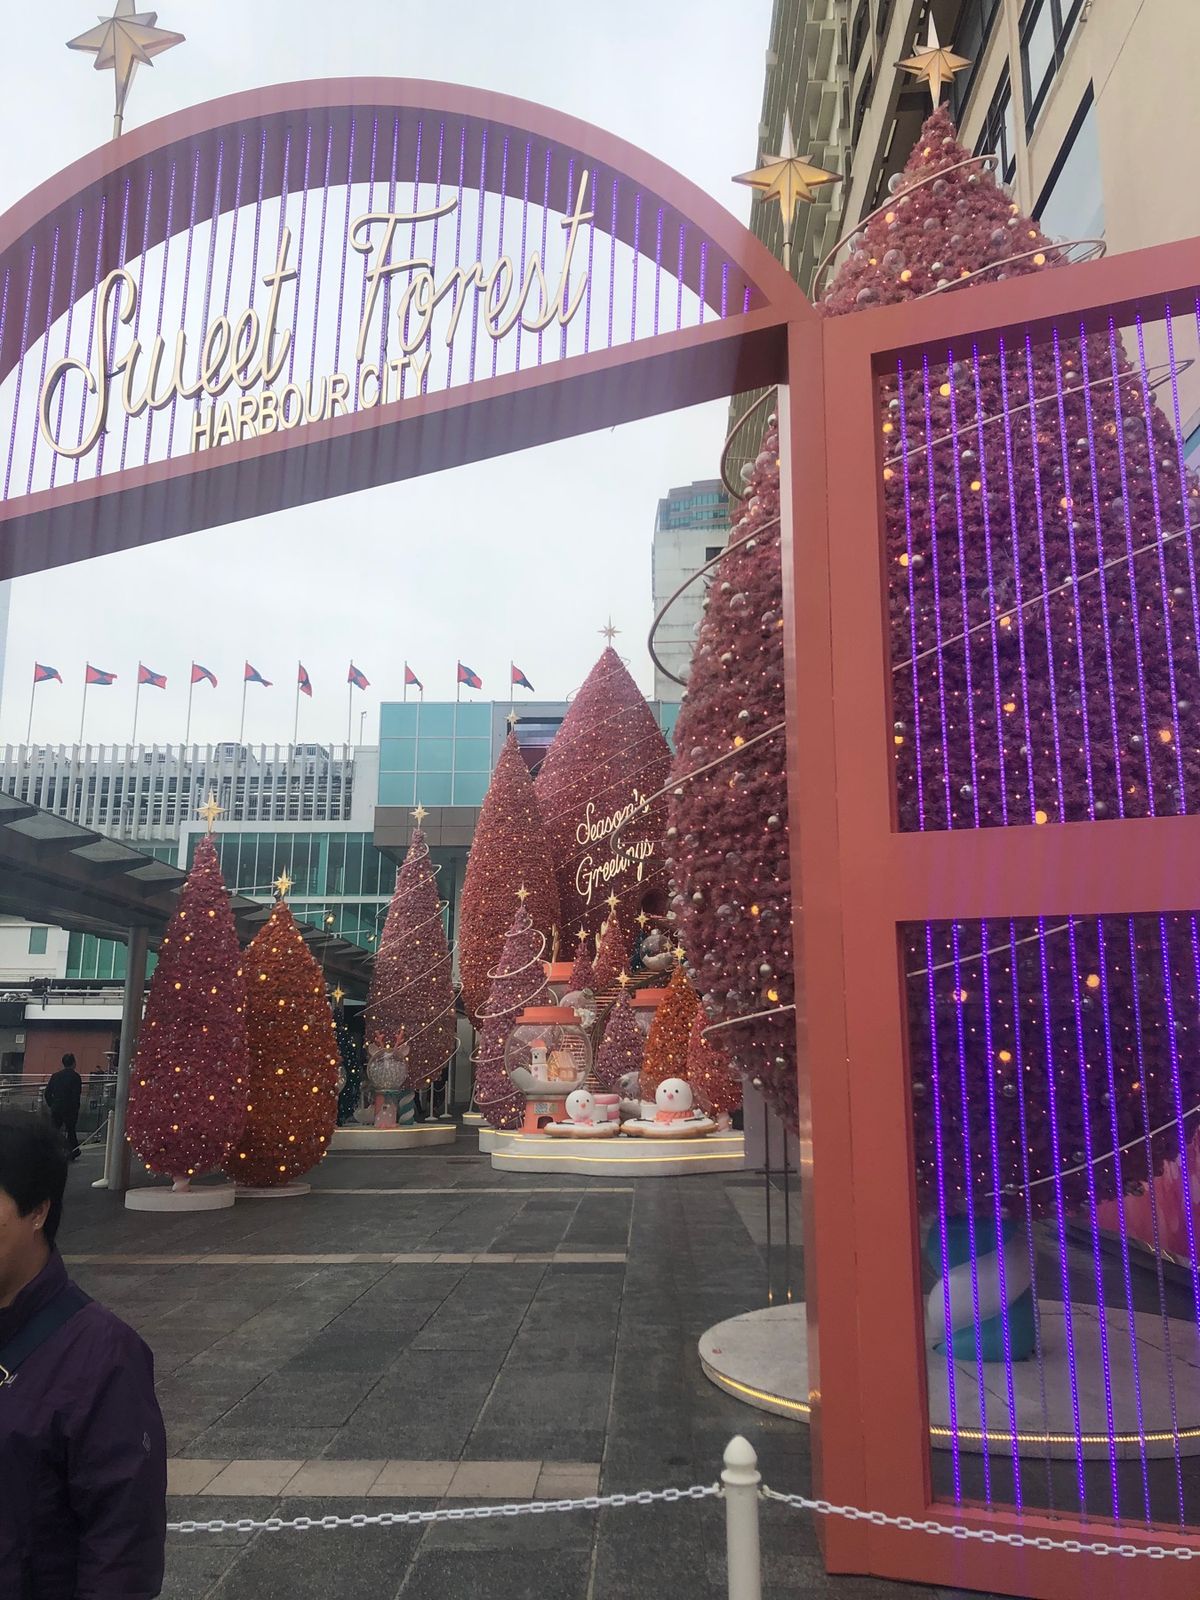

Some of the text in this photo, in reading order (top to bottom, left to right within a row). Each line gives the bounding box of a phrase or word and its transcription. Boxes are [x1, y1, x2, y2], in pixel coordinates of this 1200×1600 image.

[40, 169, 595, 456] Sweet Forest
[193, 352, 432, 452] HARBOUR CITY
[576, 788, 650, 844] Season's
